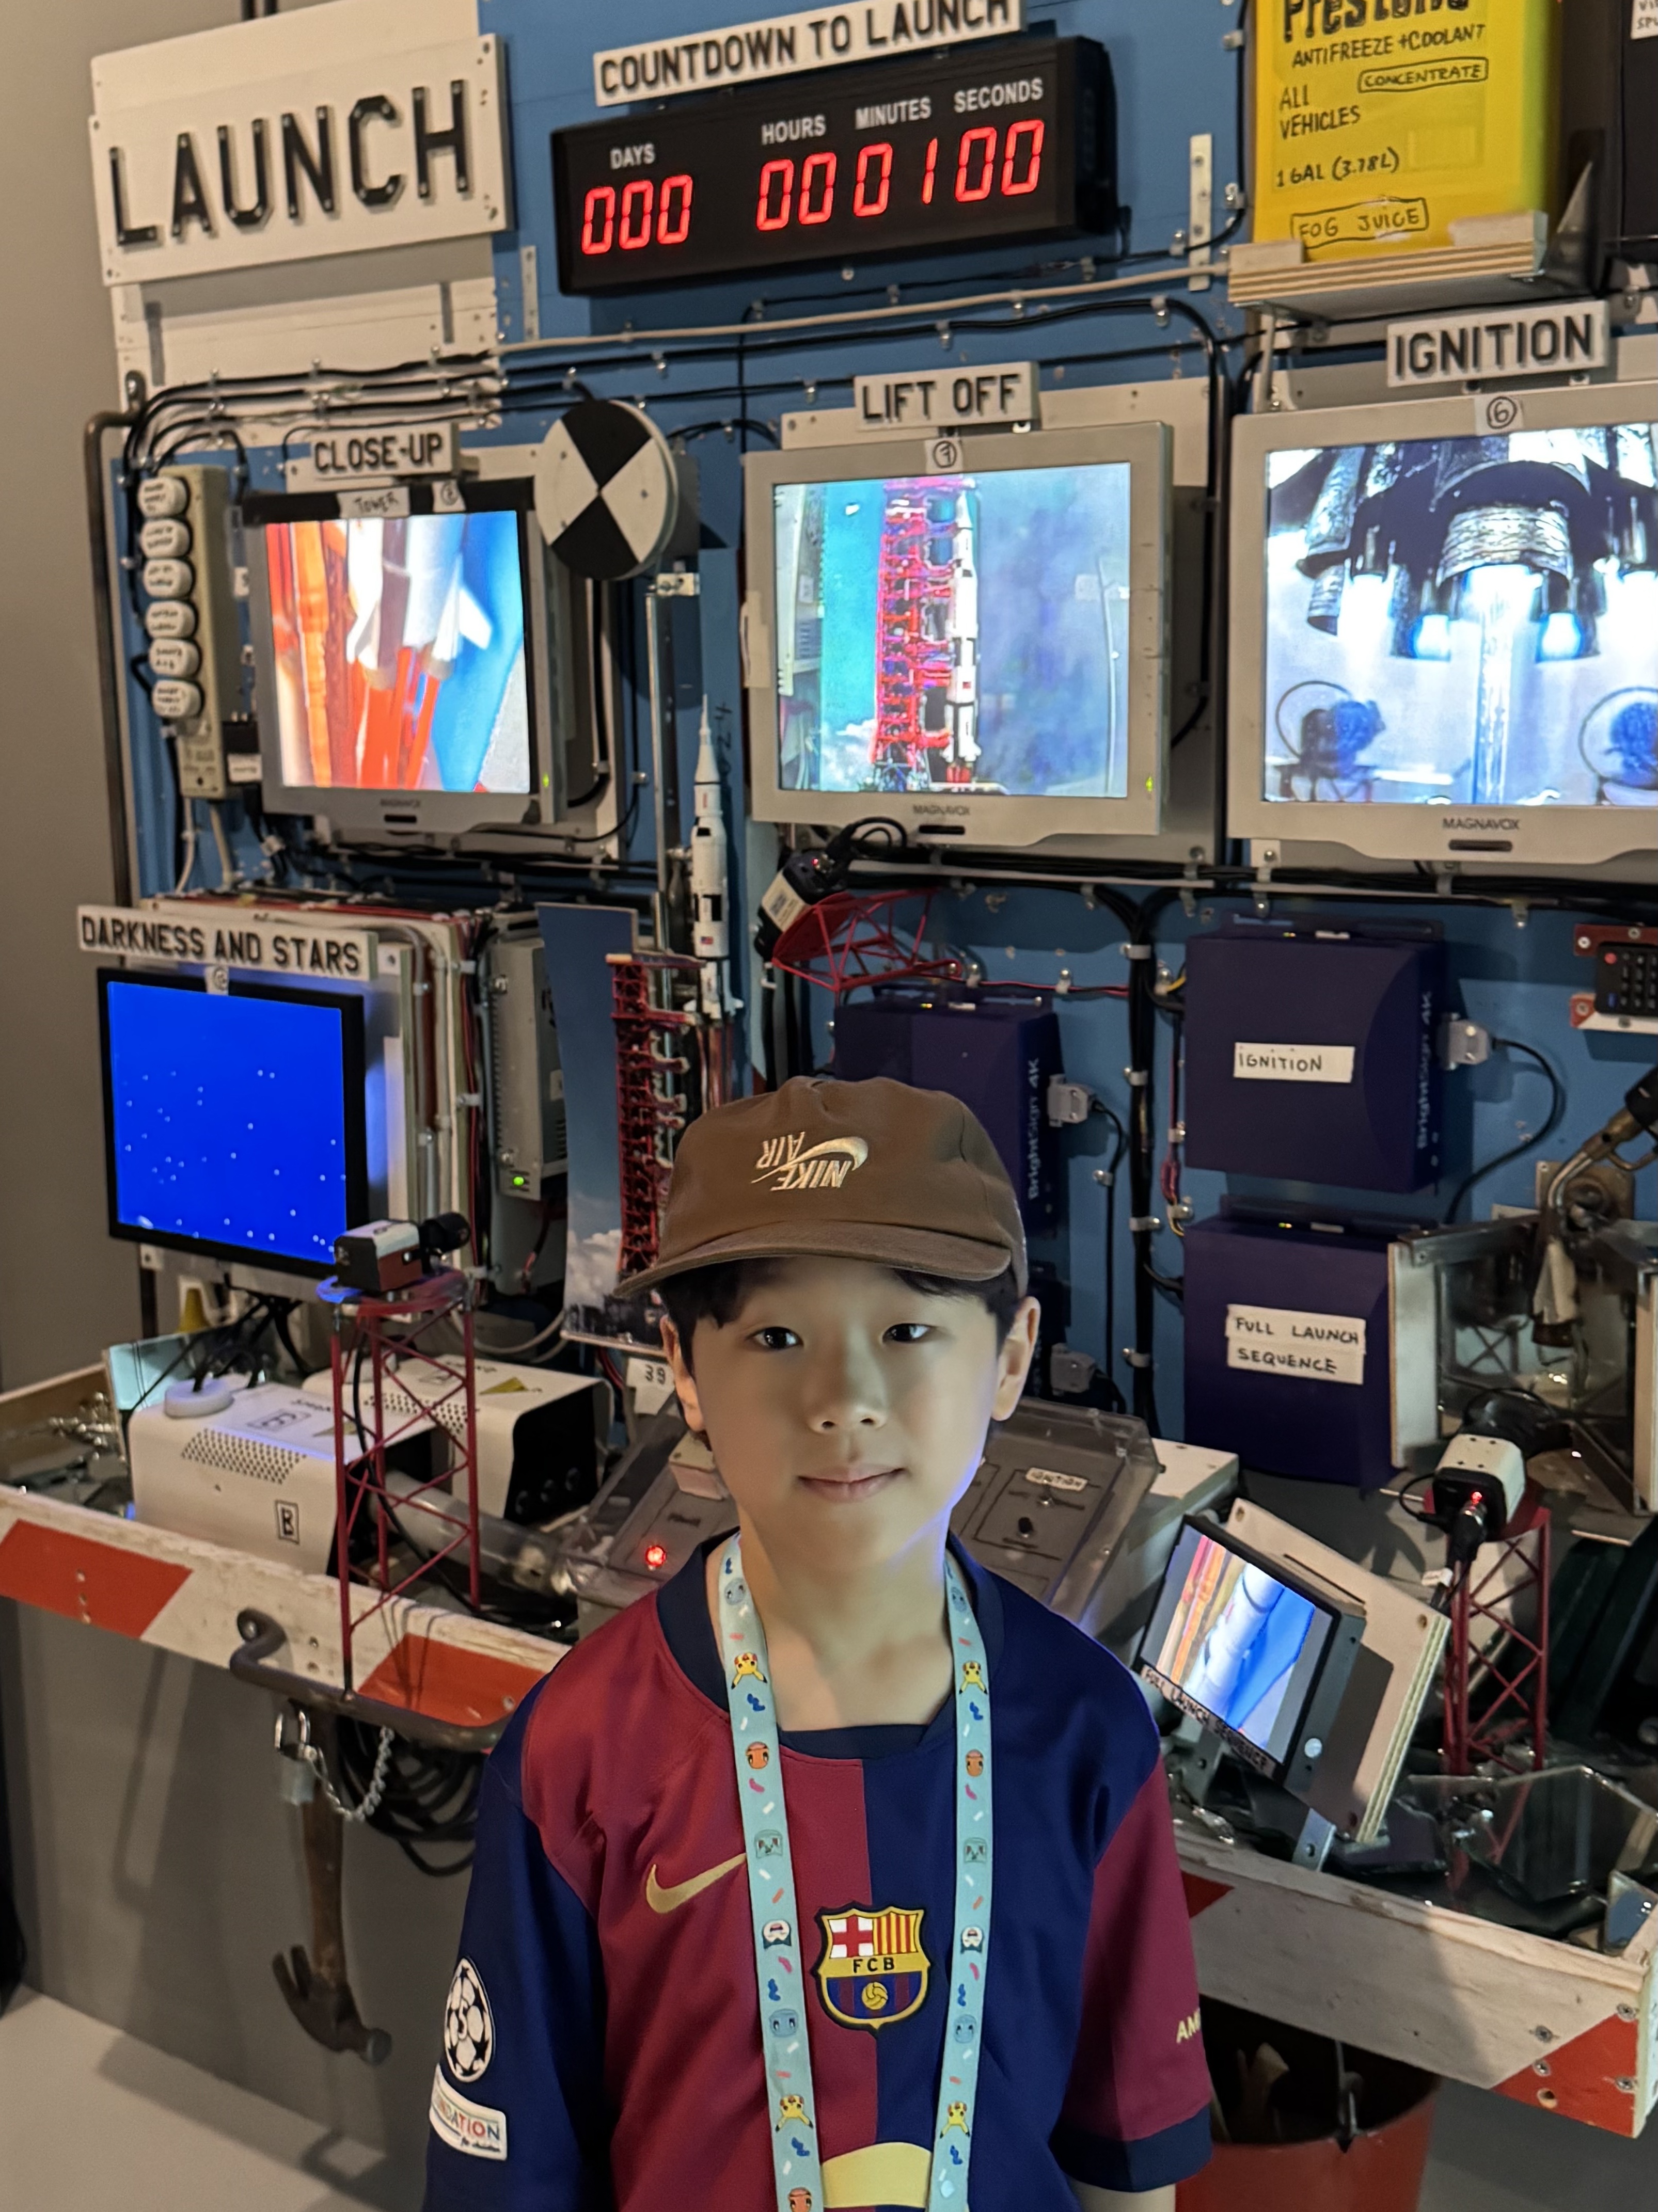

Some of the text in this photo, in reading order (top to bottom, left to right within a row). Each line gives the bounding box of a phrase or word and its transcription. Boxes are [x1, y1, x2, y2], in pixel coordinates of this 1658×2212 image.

[601, 0, 1009, 93] COUNTDOWN TO LAUNCH
[1292, 36, 1393, 68] ANTIFREEZE
[1365, 64, 1481, 87] CONCENTRATE
[1280, 84, 1310, 110] ALL
[610, 79, 1044, 169] DAYS HOURS MINUTES SECONDS
[1280, 105, 1361, 140] VEHICLES
[109, 79, 468, 246] LAUNCH
[1290, 167, 1323, 184] GAL
[581, 174, 693, 255] 000
[1299, 208, 1420, 238] FOG JUICE
[1395, 313, 1591, 377] IGNITION
[862, 373, 1021, 419] LIFT OFF
[314, 432, 443, 473] CLOSE-UP
[1442, 817, 1521, 831] MAGNAVOX
[81, 915, 360, 974] DARKNESS AND STARS
[1028, 1057, 1039, 1089] 4K
[1239, 1053, 1322, 1072] IGNITION
[770, 1159, 852, 1191] NIKE
[1236, 1317, 1360, 1345] FULL LAUNCH
[1238, 1347, 1337, 1375] SEQUENCE
[852, 1956, 895, 1974] FCB
